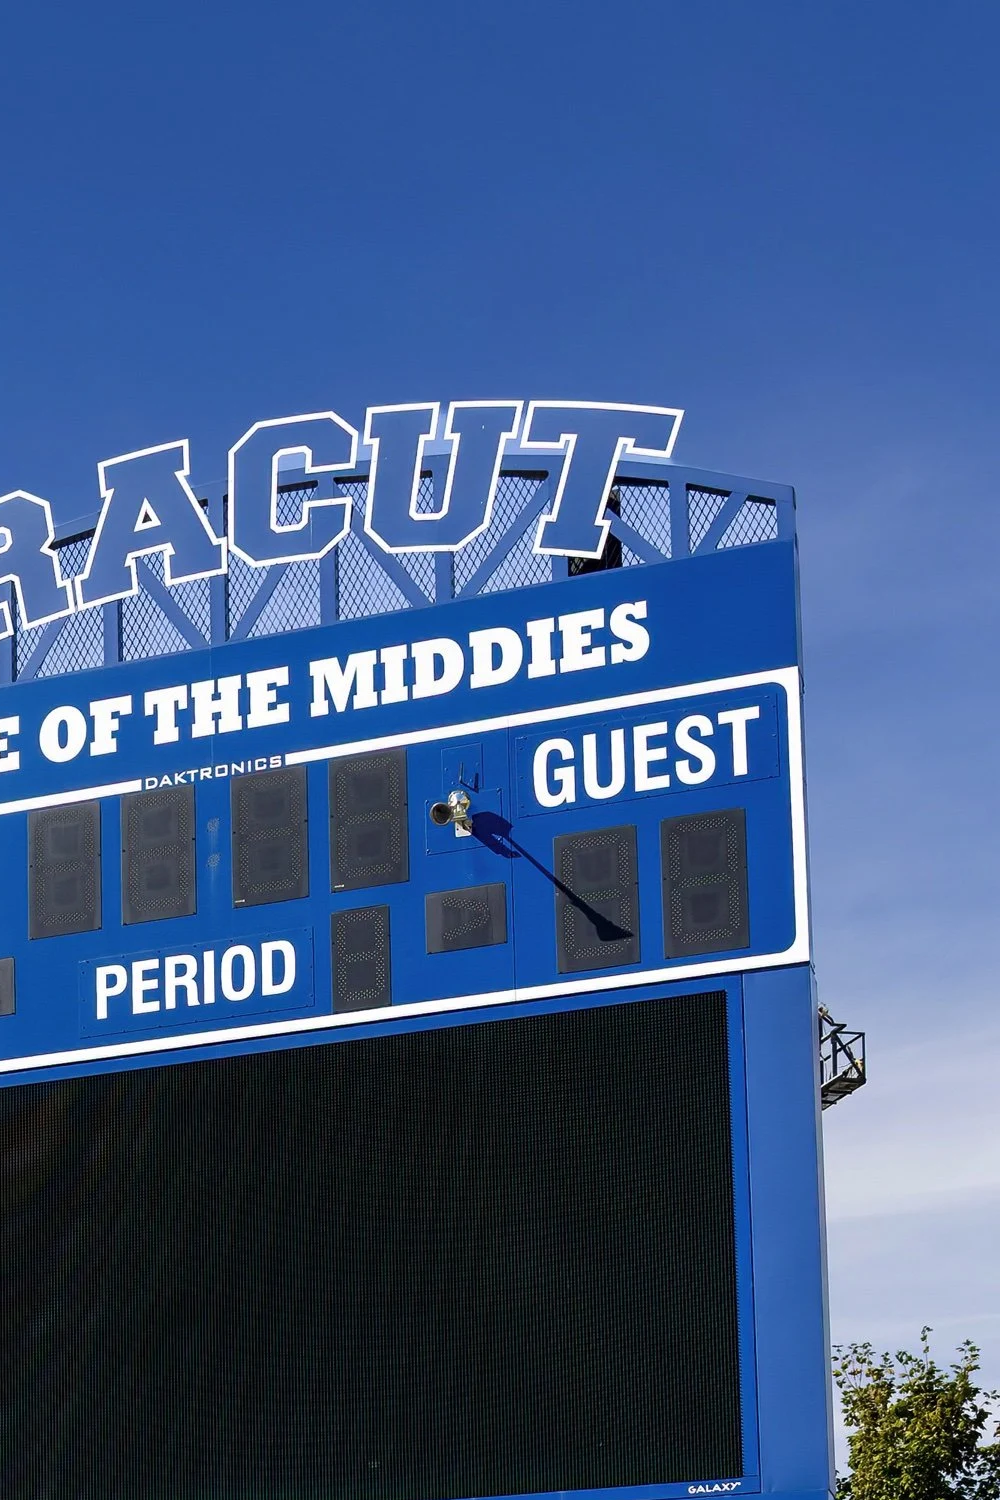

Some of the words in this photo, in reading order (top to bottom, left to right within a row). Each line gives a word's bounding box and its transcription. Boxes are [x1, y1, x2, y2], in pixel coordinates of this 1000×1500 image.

[39, 694, 133, 763] OF
[144, 666, 290, 746] THE
[309, 600, 650, 718] MIDDIES
[145, 755, 282, 791] DAKTRONICS
[532, 706, 760, 808] GUEST
[96, 940, 296, 1020] PERIOD
